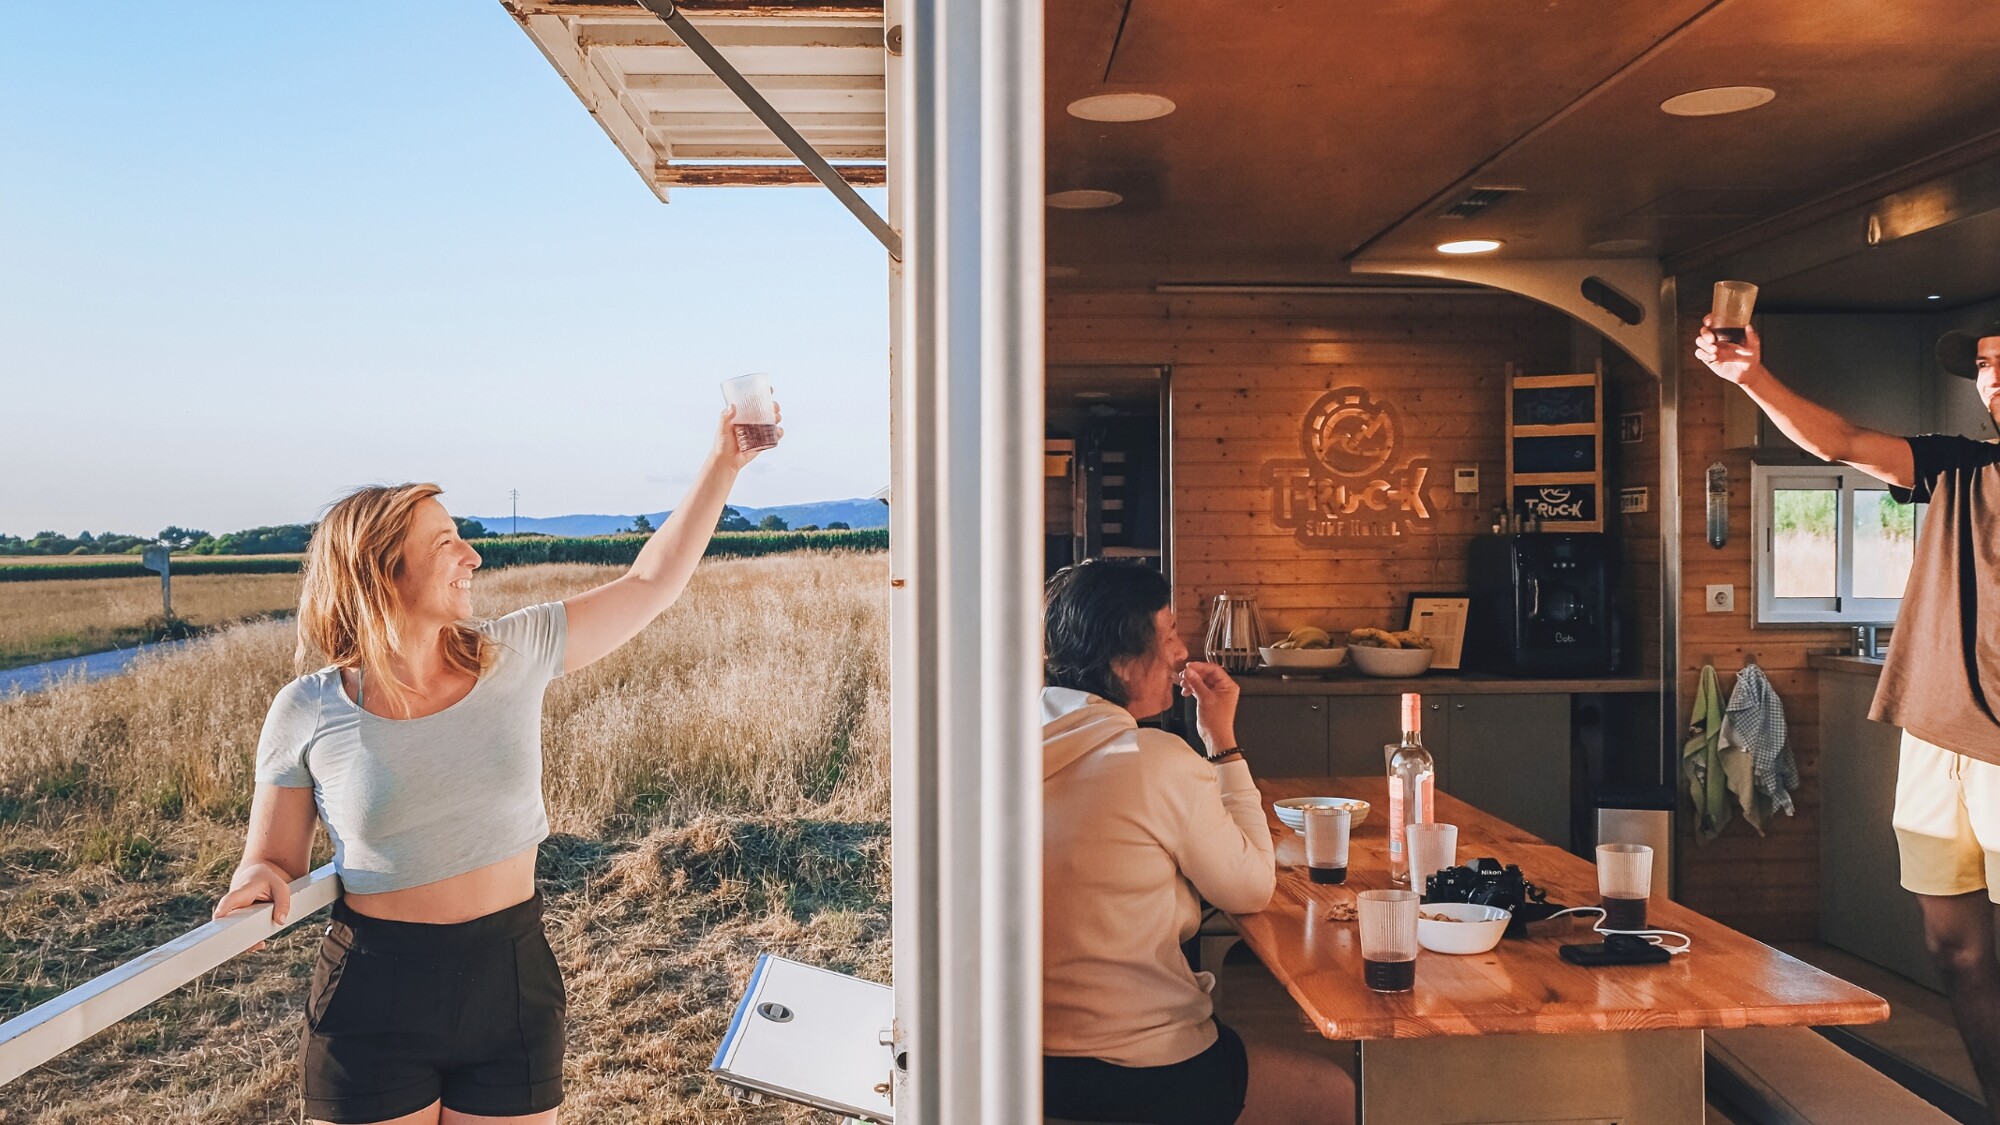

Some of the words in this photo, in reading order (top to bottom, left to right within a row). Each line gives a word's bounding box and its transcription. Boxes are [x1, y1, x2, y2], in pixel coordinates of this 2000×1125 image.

[1272, 467, 1430, 519] TRUCK
[1524, 499, 1583, 518] TRUCK
[1306, 520, 1345, 537] SURF
